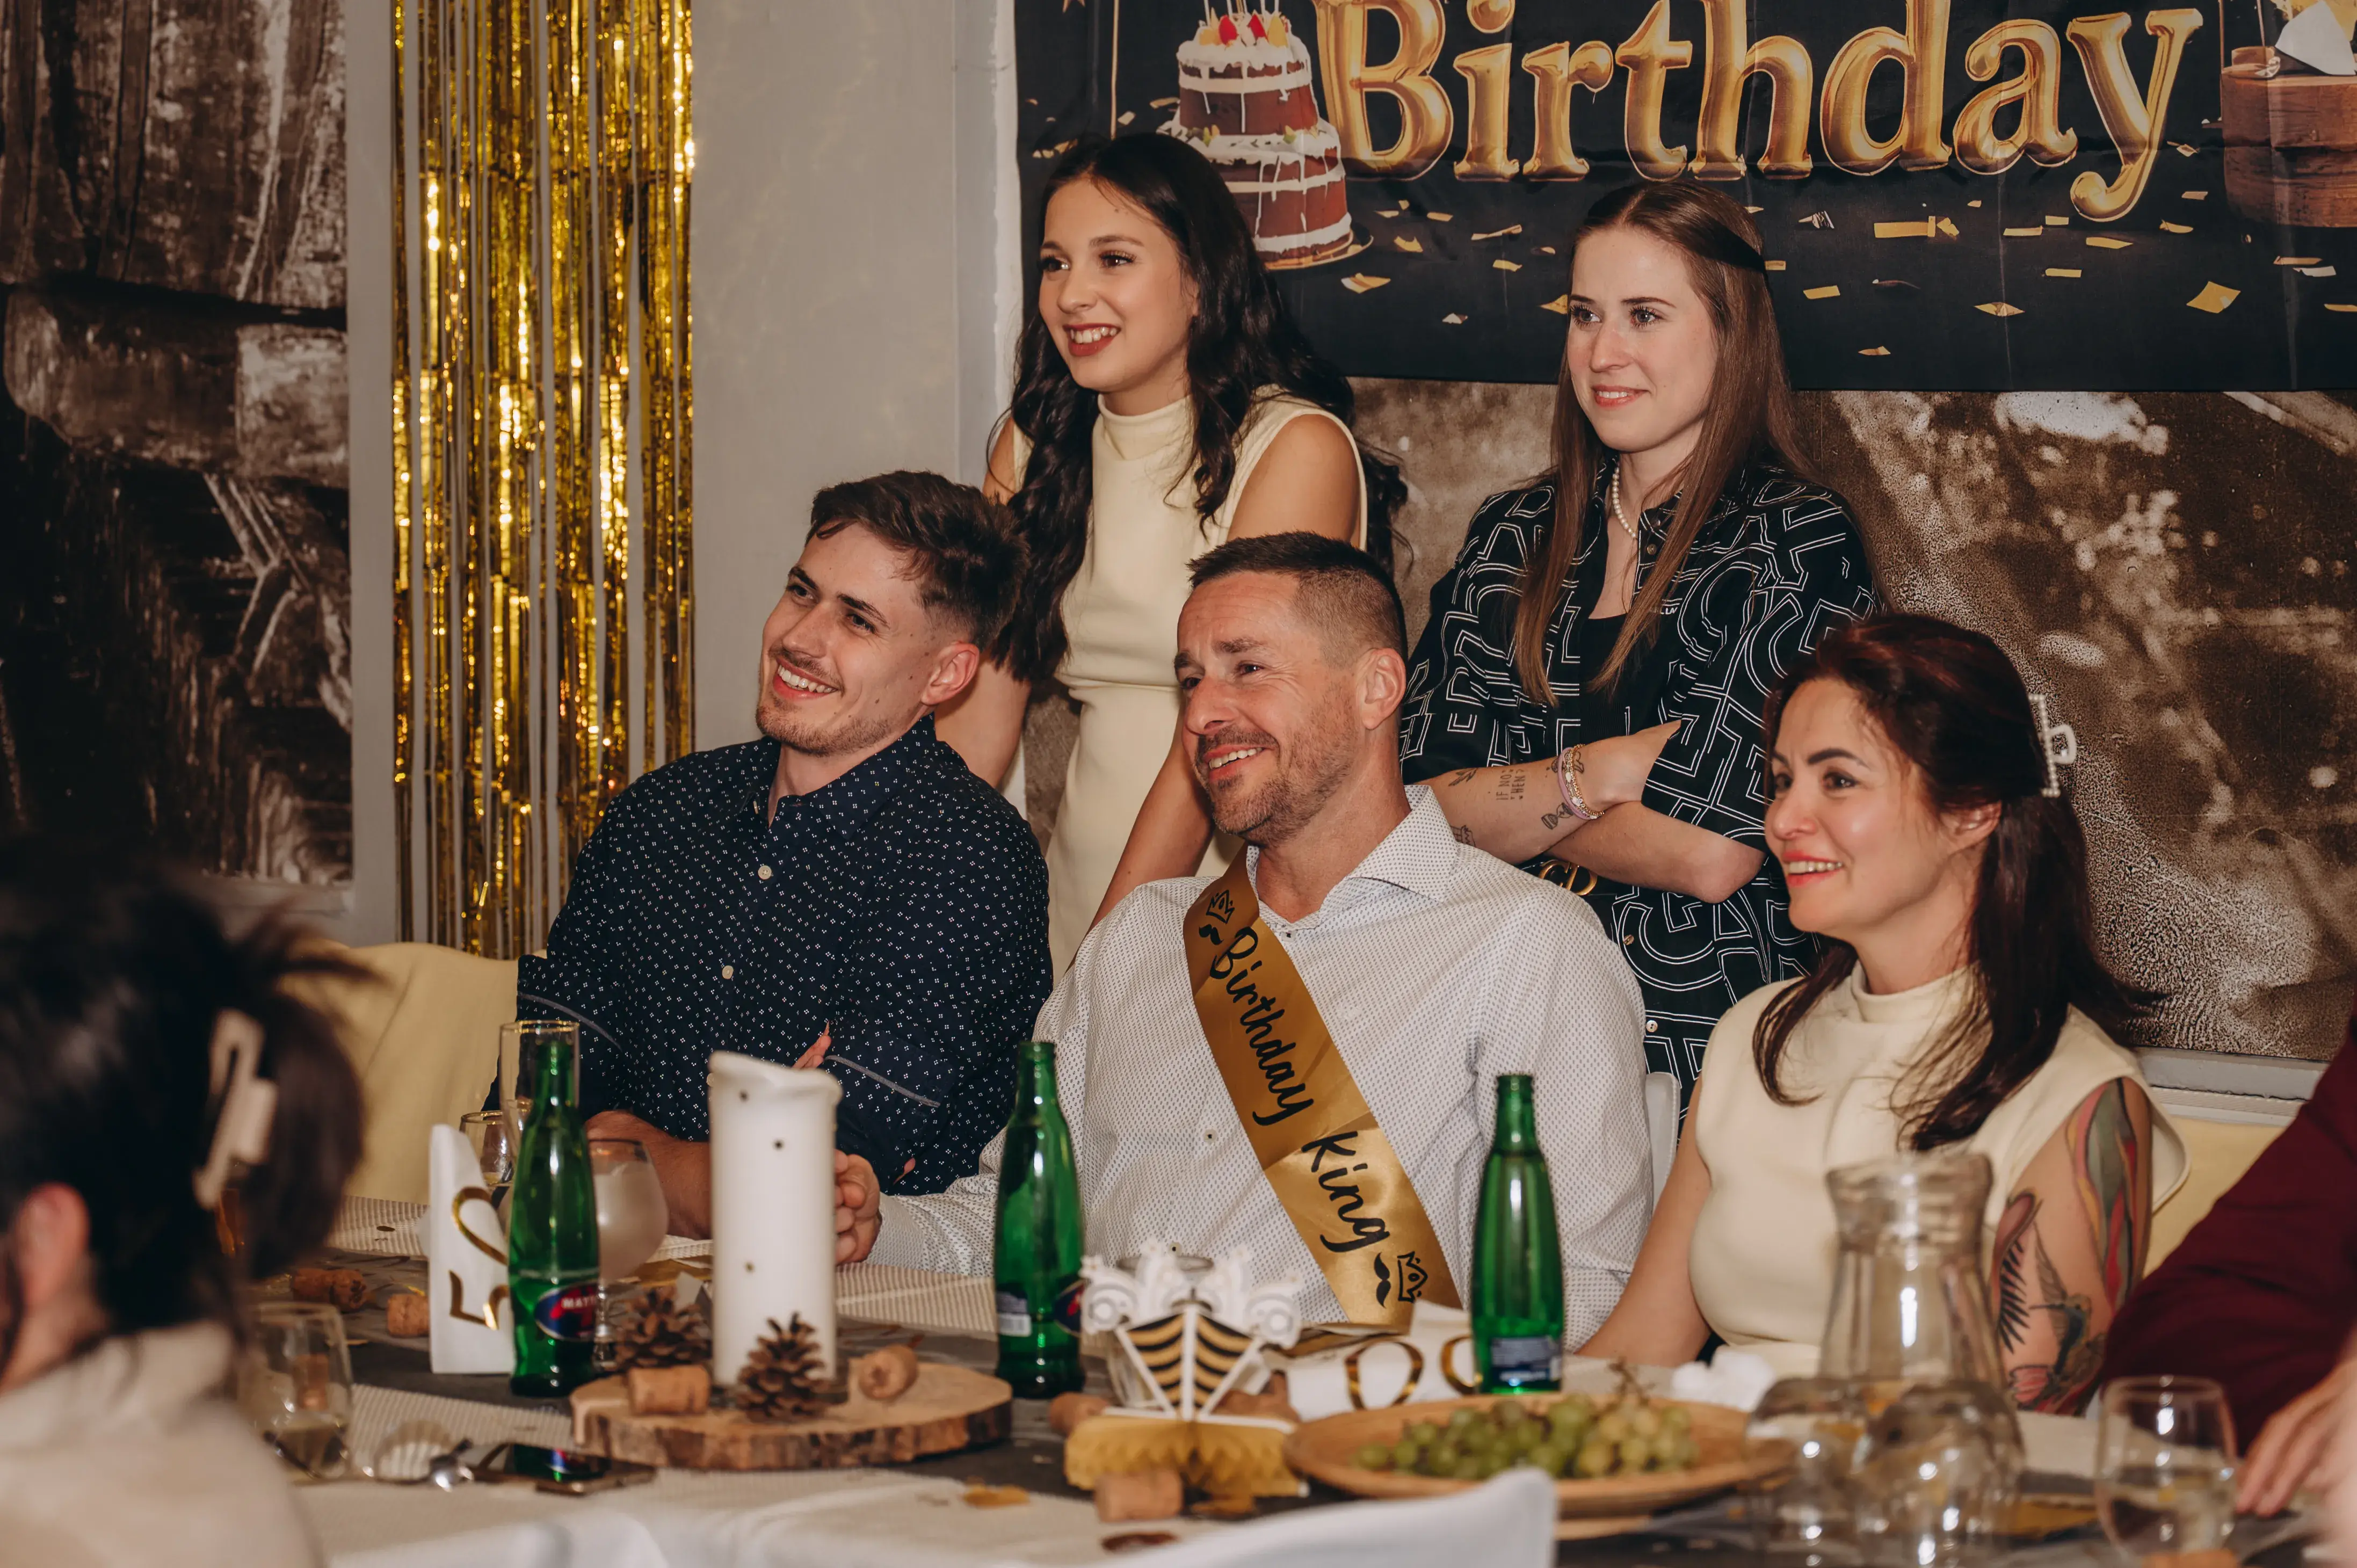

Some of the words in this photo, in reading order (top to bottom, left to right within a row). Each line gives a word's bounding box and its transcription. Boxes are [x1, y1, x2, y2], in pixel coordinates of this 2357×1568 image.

[1312, 0, 2203, 222] Birthday
[1209, 926, 1314, 1127] Birthday
[1301, 1130, 1390, 1253] King
